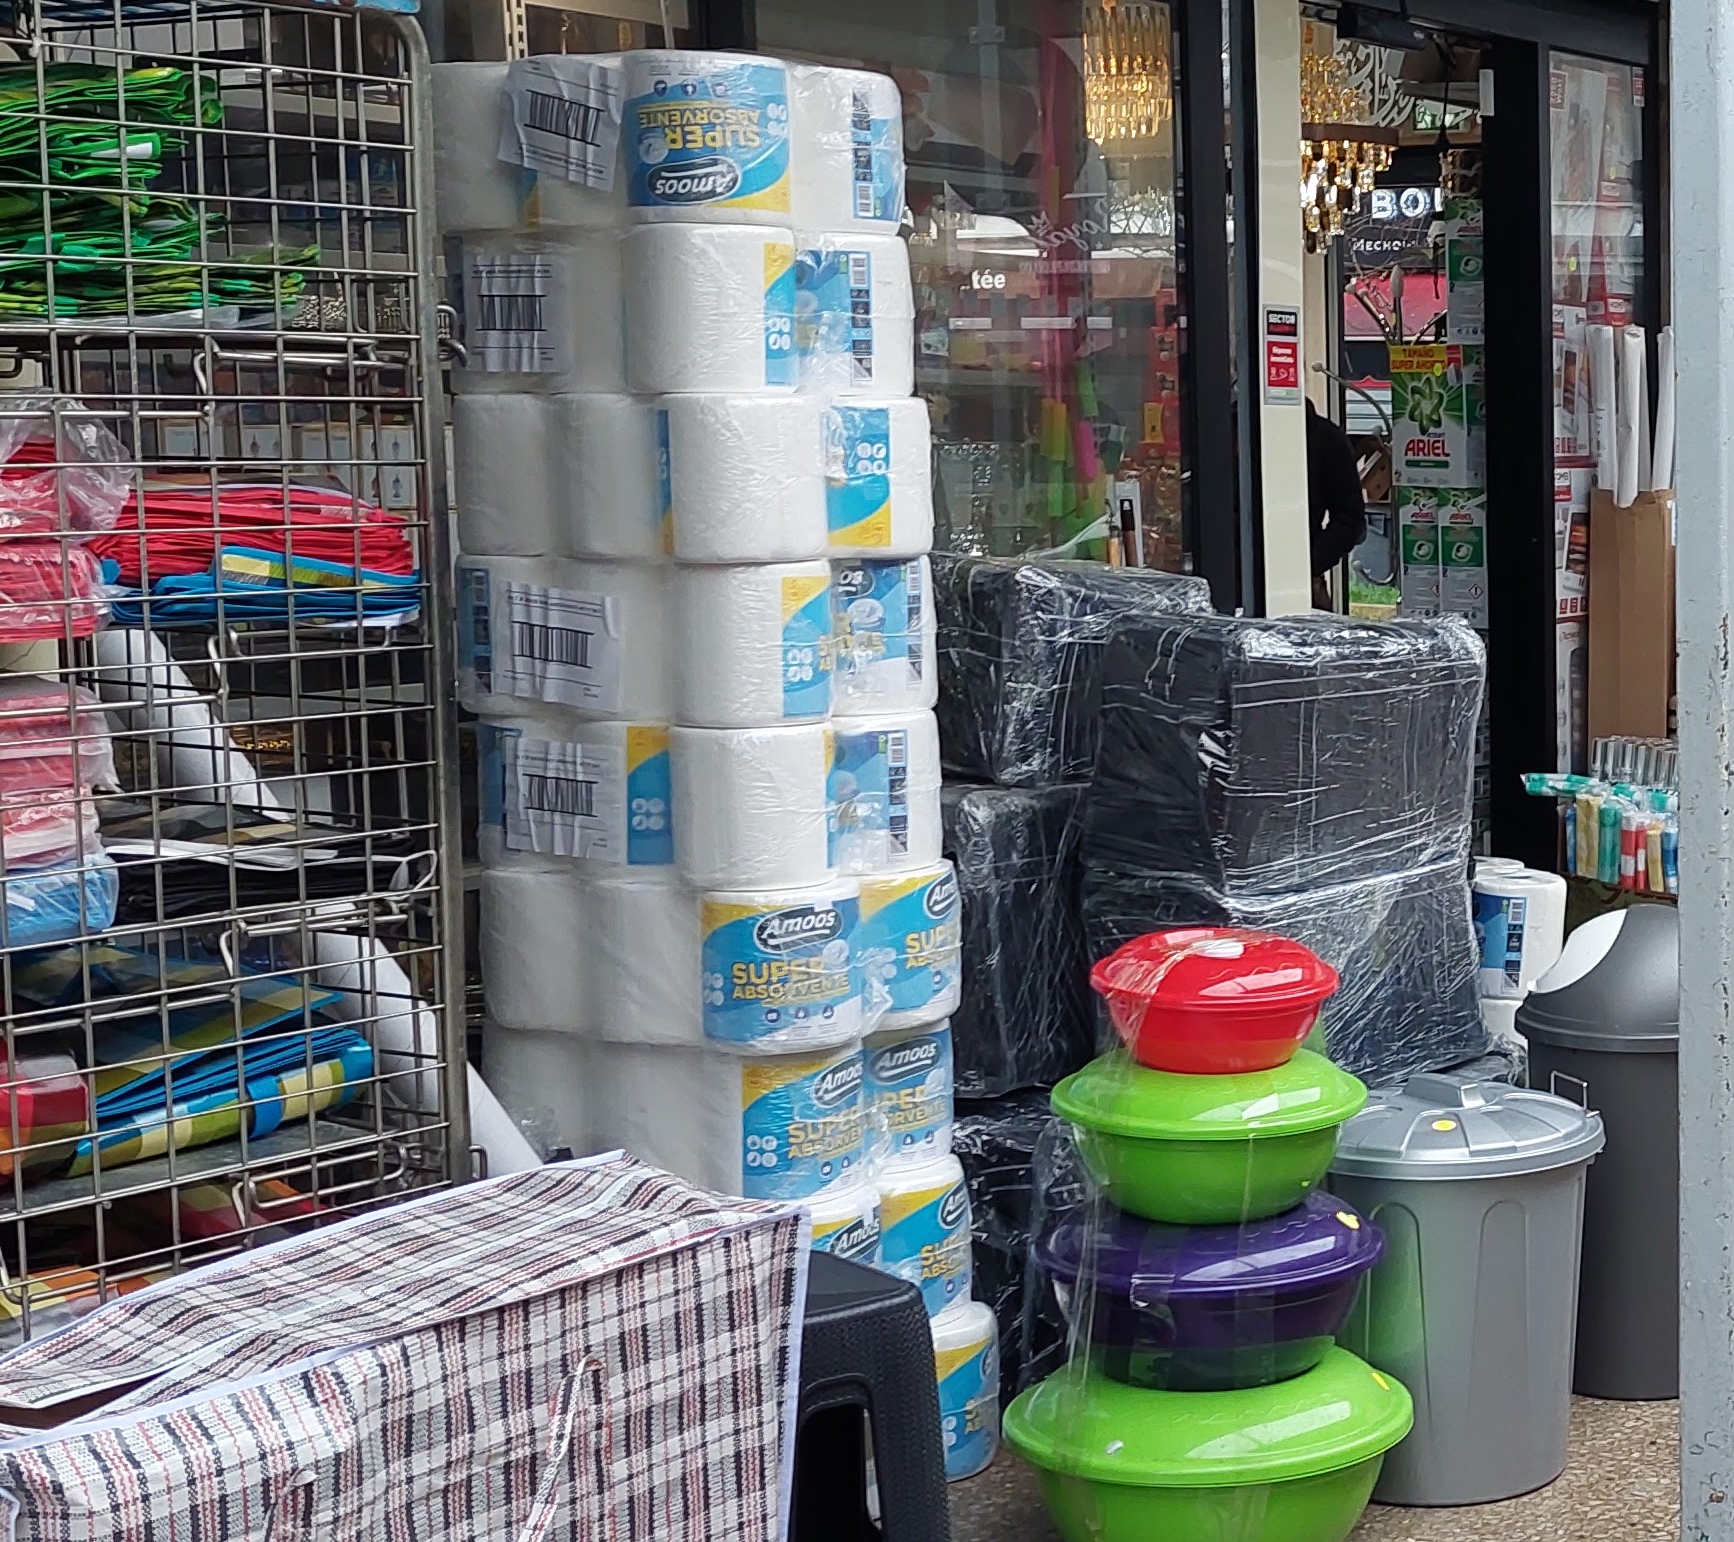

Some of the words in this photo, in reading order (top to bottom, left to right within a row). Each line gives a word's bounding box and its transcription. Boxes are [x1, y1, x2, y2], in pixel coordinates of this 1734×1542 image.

[639, 106, 761, 128] ABSORVENTE
[664, 124, 761, 151] SUPER
[653, 169, 737, 196] Amoos
[1404, 438, 1451, 458] ARIEL
[762, 909, 836, 940] Amoos
[732, 957, 825, 986] SUPER
[875, 1042, 937, 1071] Amoos
